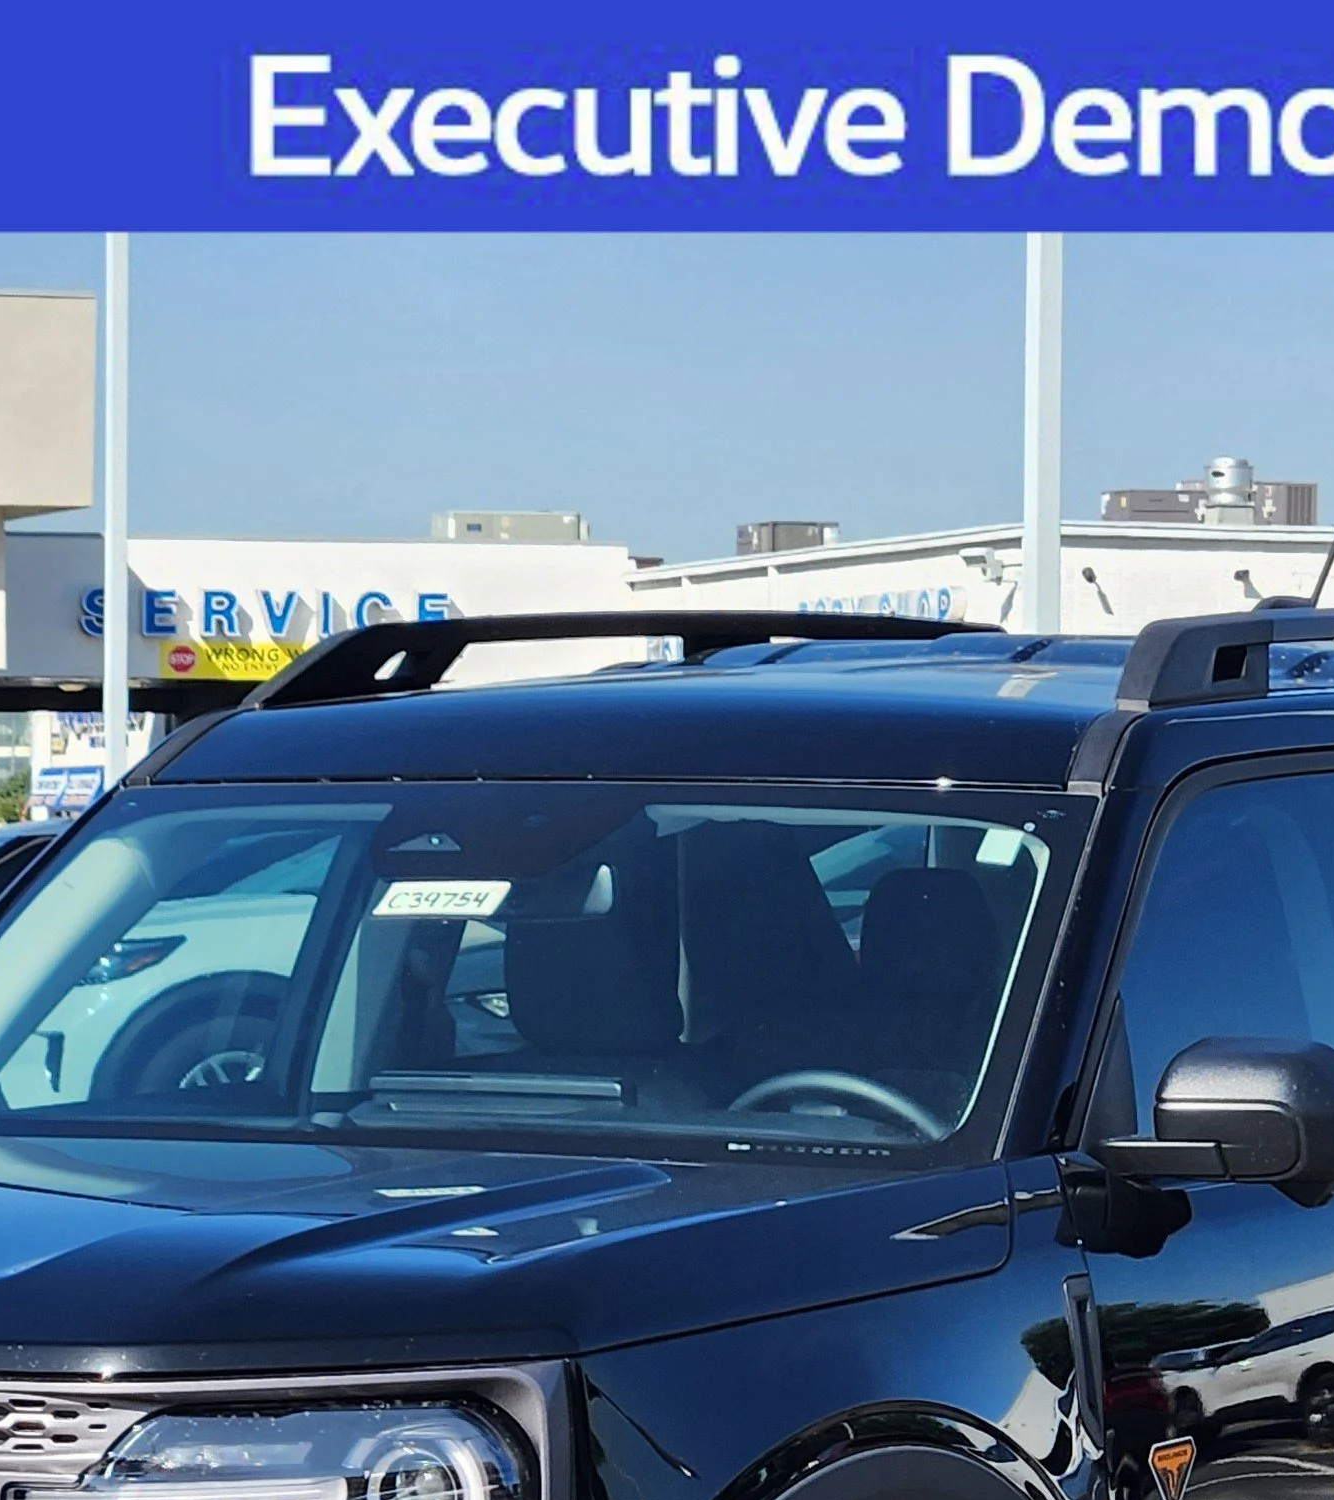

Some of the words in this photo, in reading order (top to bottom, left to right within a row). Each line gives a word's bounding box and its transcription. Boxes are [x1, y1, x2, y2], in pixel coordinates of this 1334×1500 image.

[79, 587, 451, 638] SERVICE
[169, 652, 195, 665] STOP
[205, 646, 280, 663] WRONG
